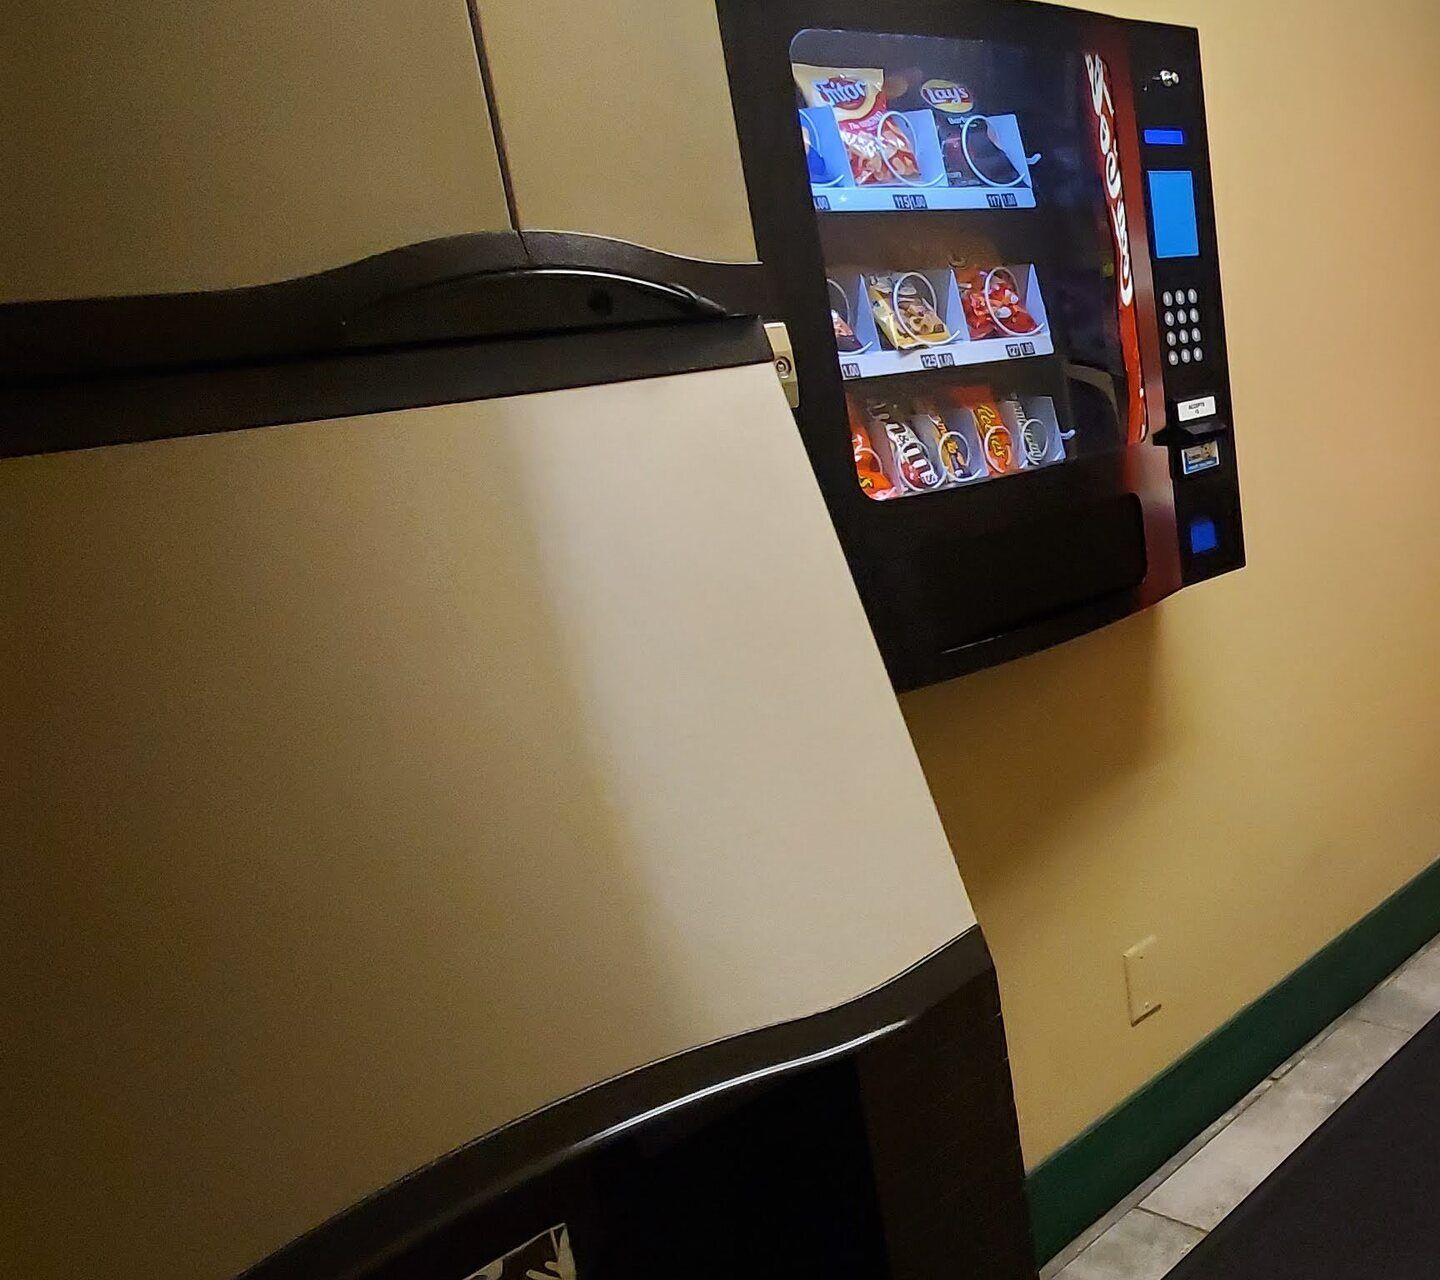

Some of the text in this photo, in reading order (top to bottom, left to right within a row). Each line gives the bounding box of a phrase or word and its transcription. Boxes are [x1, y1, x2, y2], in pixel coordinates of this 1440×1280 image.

[927, 85, 969, 105] Lay's
[895, 194, 925, 209] 115 1.00
[988, 193, 1016, 208] 117 1.00
[1007, 342, 1034, 357] 127 1.00
[923, 354, 953, 368] 125 1.00
[842, 364, 860, 378] 1.00
